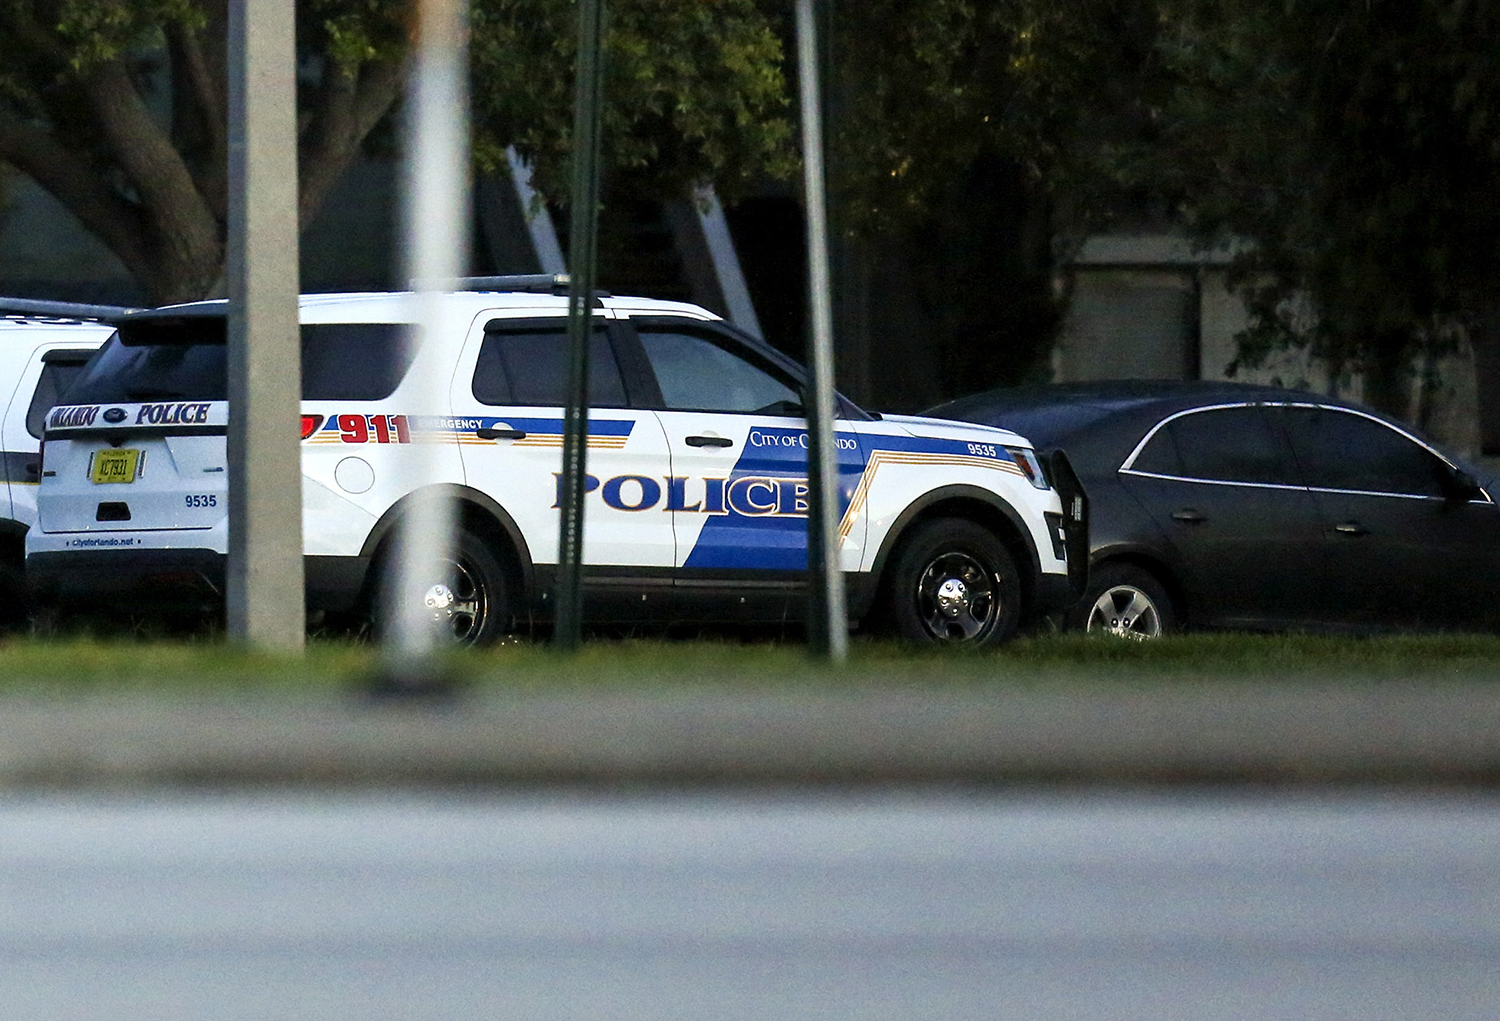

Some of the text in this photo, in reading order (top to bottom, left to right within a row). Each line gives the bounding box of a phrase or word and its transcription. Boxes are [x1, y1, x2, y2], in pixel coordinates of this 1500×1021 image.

[134, 403, 212, 425] POLICE
[338, 414, 483, 443] 911 ERGENCY
[798, 433, 857, 450] ONDO
[967, 443, 997, 457] 9535
[185, 495, 217, 508] 9535
